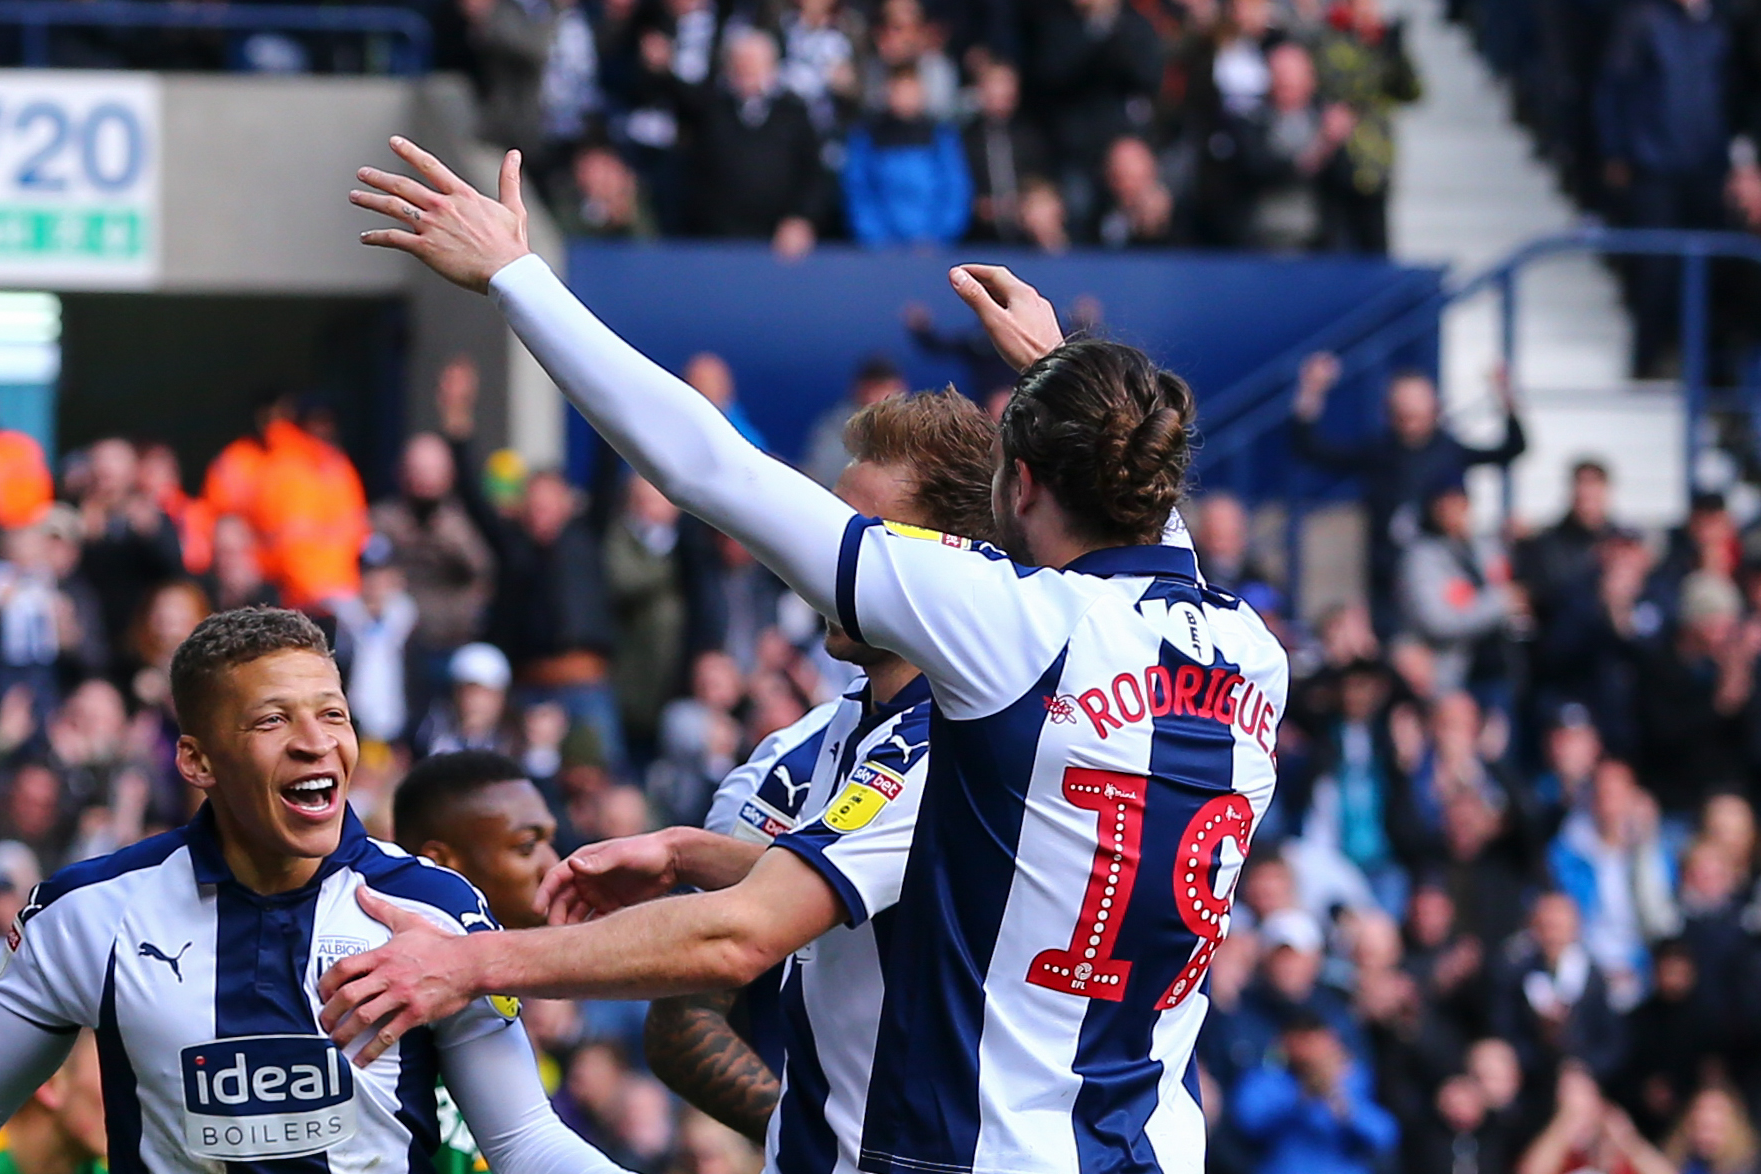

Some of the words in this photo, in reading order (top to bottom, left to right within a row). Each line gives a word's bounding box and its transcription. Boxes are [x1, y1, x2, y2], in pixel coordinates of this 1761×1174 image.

[854, 767, 875, 785] sky
[872, 774, 899, 797] bet
[1025, 766, 1254, 1012] 19
[318, 943, 367, 957] ALBION
[1071, 979, 1087, 991] EFL
[193, 1047, 341, 1106] ideal
[202, 1115, 342, 1147] BOILERS
